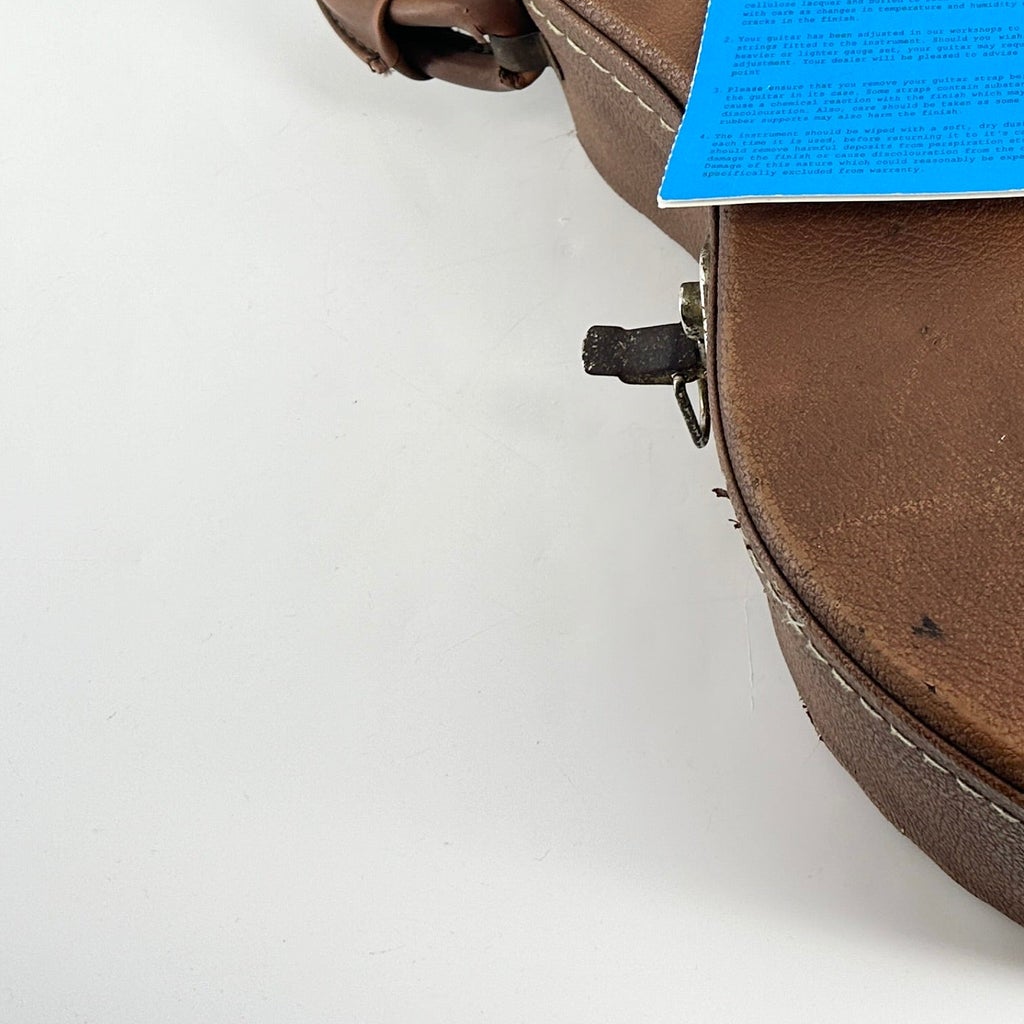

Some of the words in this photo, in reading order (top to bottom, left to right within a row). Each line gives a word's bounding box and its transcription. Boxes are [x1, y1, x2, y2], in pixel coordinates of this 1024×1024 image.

[743, 0, 796, 9] cellulose
[801, 0, 840, 8] lacquer
[816, 6, 856, 16] changes
[877, 3, 942, 13] temperature
[969, 0, 1016, 10] humidity
[741, 18, 776, 26] cracks
[766, 33, 801, 42] guitar
[857, 29, 905, 38] adjusted
[949, 25, 1002, 35] workshops
[736, 42, 777, 52] strings
[783, 41, 818, 49] fitted
[863, 36, 924, 45] instrument.
[734, 51, 774, 59] heavier
[798, 48, 838, 58] lighter
[831, 55, 866, 63] dealer
[917, 51, 960, 61] pleased
[982, 48, 1018, 57] advise
[730, 68, 760, 77] point
[726, 85, 763, 93] Please
[748, 91, 784, 101] guitar
[936, 82, 978, 90] contain
[770, 98, 817, 107] chemical
[823, 95, 871, 104] reaction
[930, 91, 965, 99] finish
[816, 104, 845, 113] Also,
[881, 101, 918, 109] should
[719, 117, 755, 125] rubber
[761, 114, 808, 124] supports
[837, 112, 862, 120] also
[739, 130, 798, 139] instrument
[804, 129, 841, 137] should
[807, 137, 835, 146] used,
[843, 135, 880, 143] before
[886, 132, 942, 143] returning
[794, 144, 836, 152] harmful
[843, 141, 892, 151] deposits
[928, 137, 1003, 148] perspiration
[703, 162, 742, 170] Damage
[913, 154, 975, 164] reasonably
[706, 154, 744, 163] damage
[774, 152, 811, 160] finish
[871, 147, 958, 157] discolouration
[701, 170, 776, 179] specifically
[781, 168, 833, 176] excluded
[869, 165, 924, 175] warranty.
